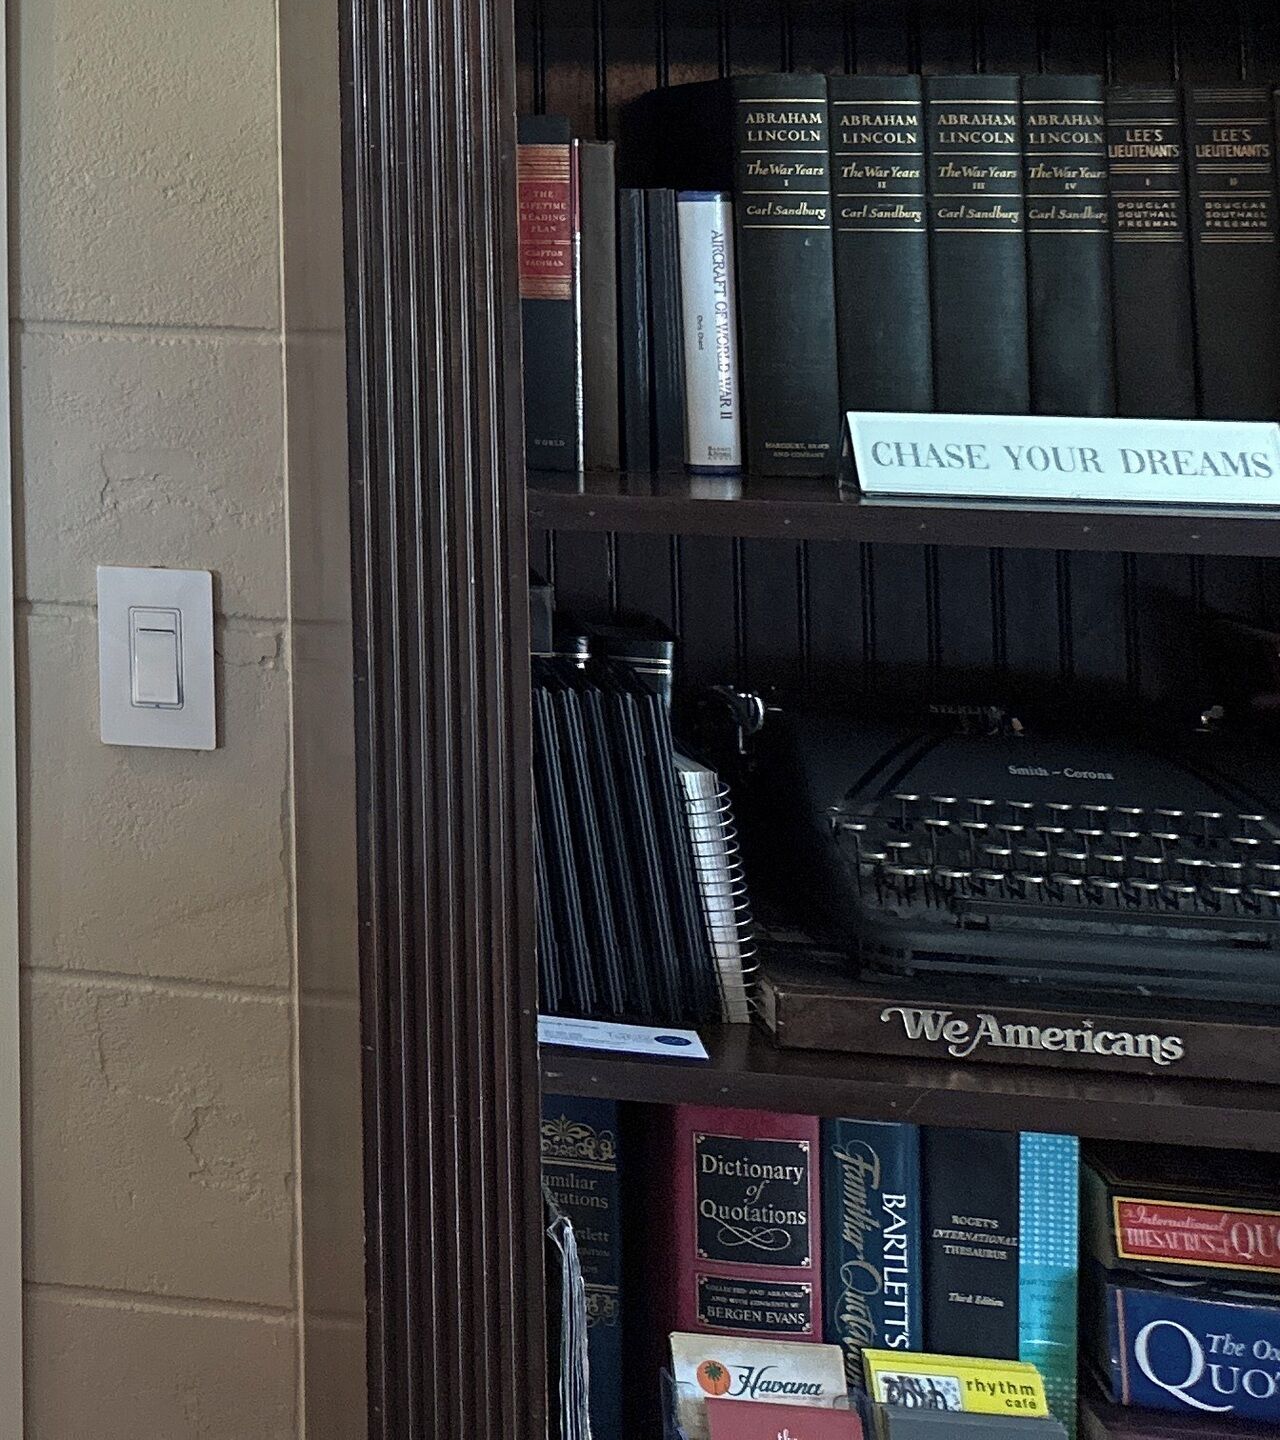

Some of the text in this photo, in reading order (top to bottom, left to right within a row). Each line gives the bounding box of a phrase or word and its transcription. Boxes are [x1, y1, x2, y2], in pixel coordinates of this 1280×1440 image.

[745, 113, 822, 124] ABRAHAM
[840, 115, 918, 126] ABRAHAM
[937, 114, 1016, 126] ABRAHAM
[1028, 115, 1104, 126] ABRAHAM
[748, 130, 821, 142] LINCOLN
[842, 132, 917, 144] LINCOLN
[940, 132, 1015, 144] LINCOLN
[1029, 132, 1104, 144] LINCOLN
[1126, 129, 1163, 142] LEE'S
[1213, 129, 1252, 142] LEE'S
[1108, 144, 1180, 158] LIEUTENANTS
[1195, 144, 1271, 158] LIEUTENANTS
[746, 160, 824, 176] The War Years
[841, 162, 920, 178] The War Years
[938, 162, 1017, 178] The War Years
[1028, 162, 1107, 178] The War Years
[746, 202, 827, 220] Carl Sandburg
[841, 205, 922, 222] Carl Sandburg
[938, 205, 1020, 223] Carl Sandburg
[1028, 205, 1108, 224] Carl Sandburg
[711, 229, 728, 298] AIRCRAFT
[714, 301, 729, 315] OF
[719, 375, 732, 408] WAR
[720, 411, 733, 420] II
[871, 441, 1274, 479] CHASE YOUR DREAMS
[1007, 765, 1115, 780] Smith Corona
[880, 1007, 1185, 1065] We Americans
[701, 1153, 804, 1185] Dictionary
[744, 1179, 770, 1205] of
[831, 1140, 880, 1260] Familiar
[700, 1199, 807, 1232] Quotations
[951, 1215, 999, 1229] ROGET'S
[932, 1229, 1018, 1247] INTERNATIONAL
[943, 1245, 1008, 1260] THESAURUS
[882, 1193, 910, 1349] BARTLETT'S
[707, 1306, 805, 1325] BERGEN EVANS
[1206, 1333, 1246, 1357] The
[1135, 1320, 1280, 1412] QUO
[727, 1365, 824, 1399] Havana
[966, 1377, 1035, 1396] rhythm
[1005, 1398, 1037, 1410] café
